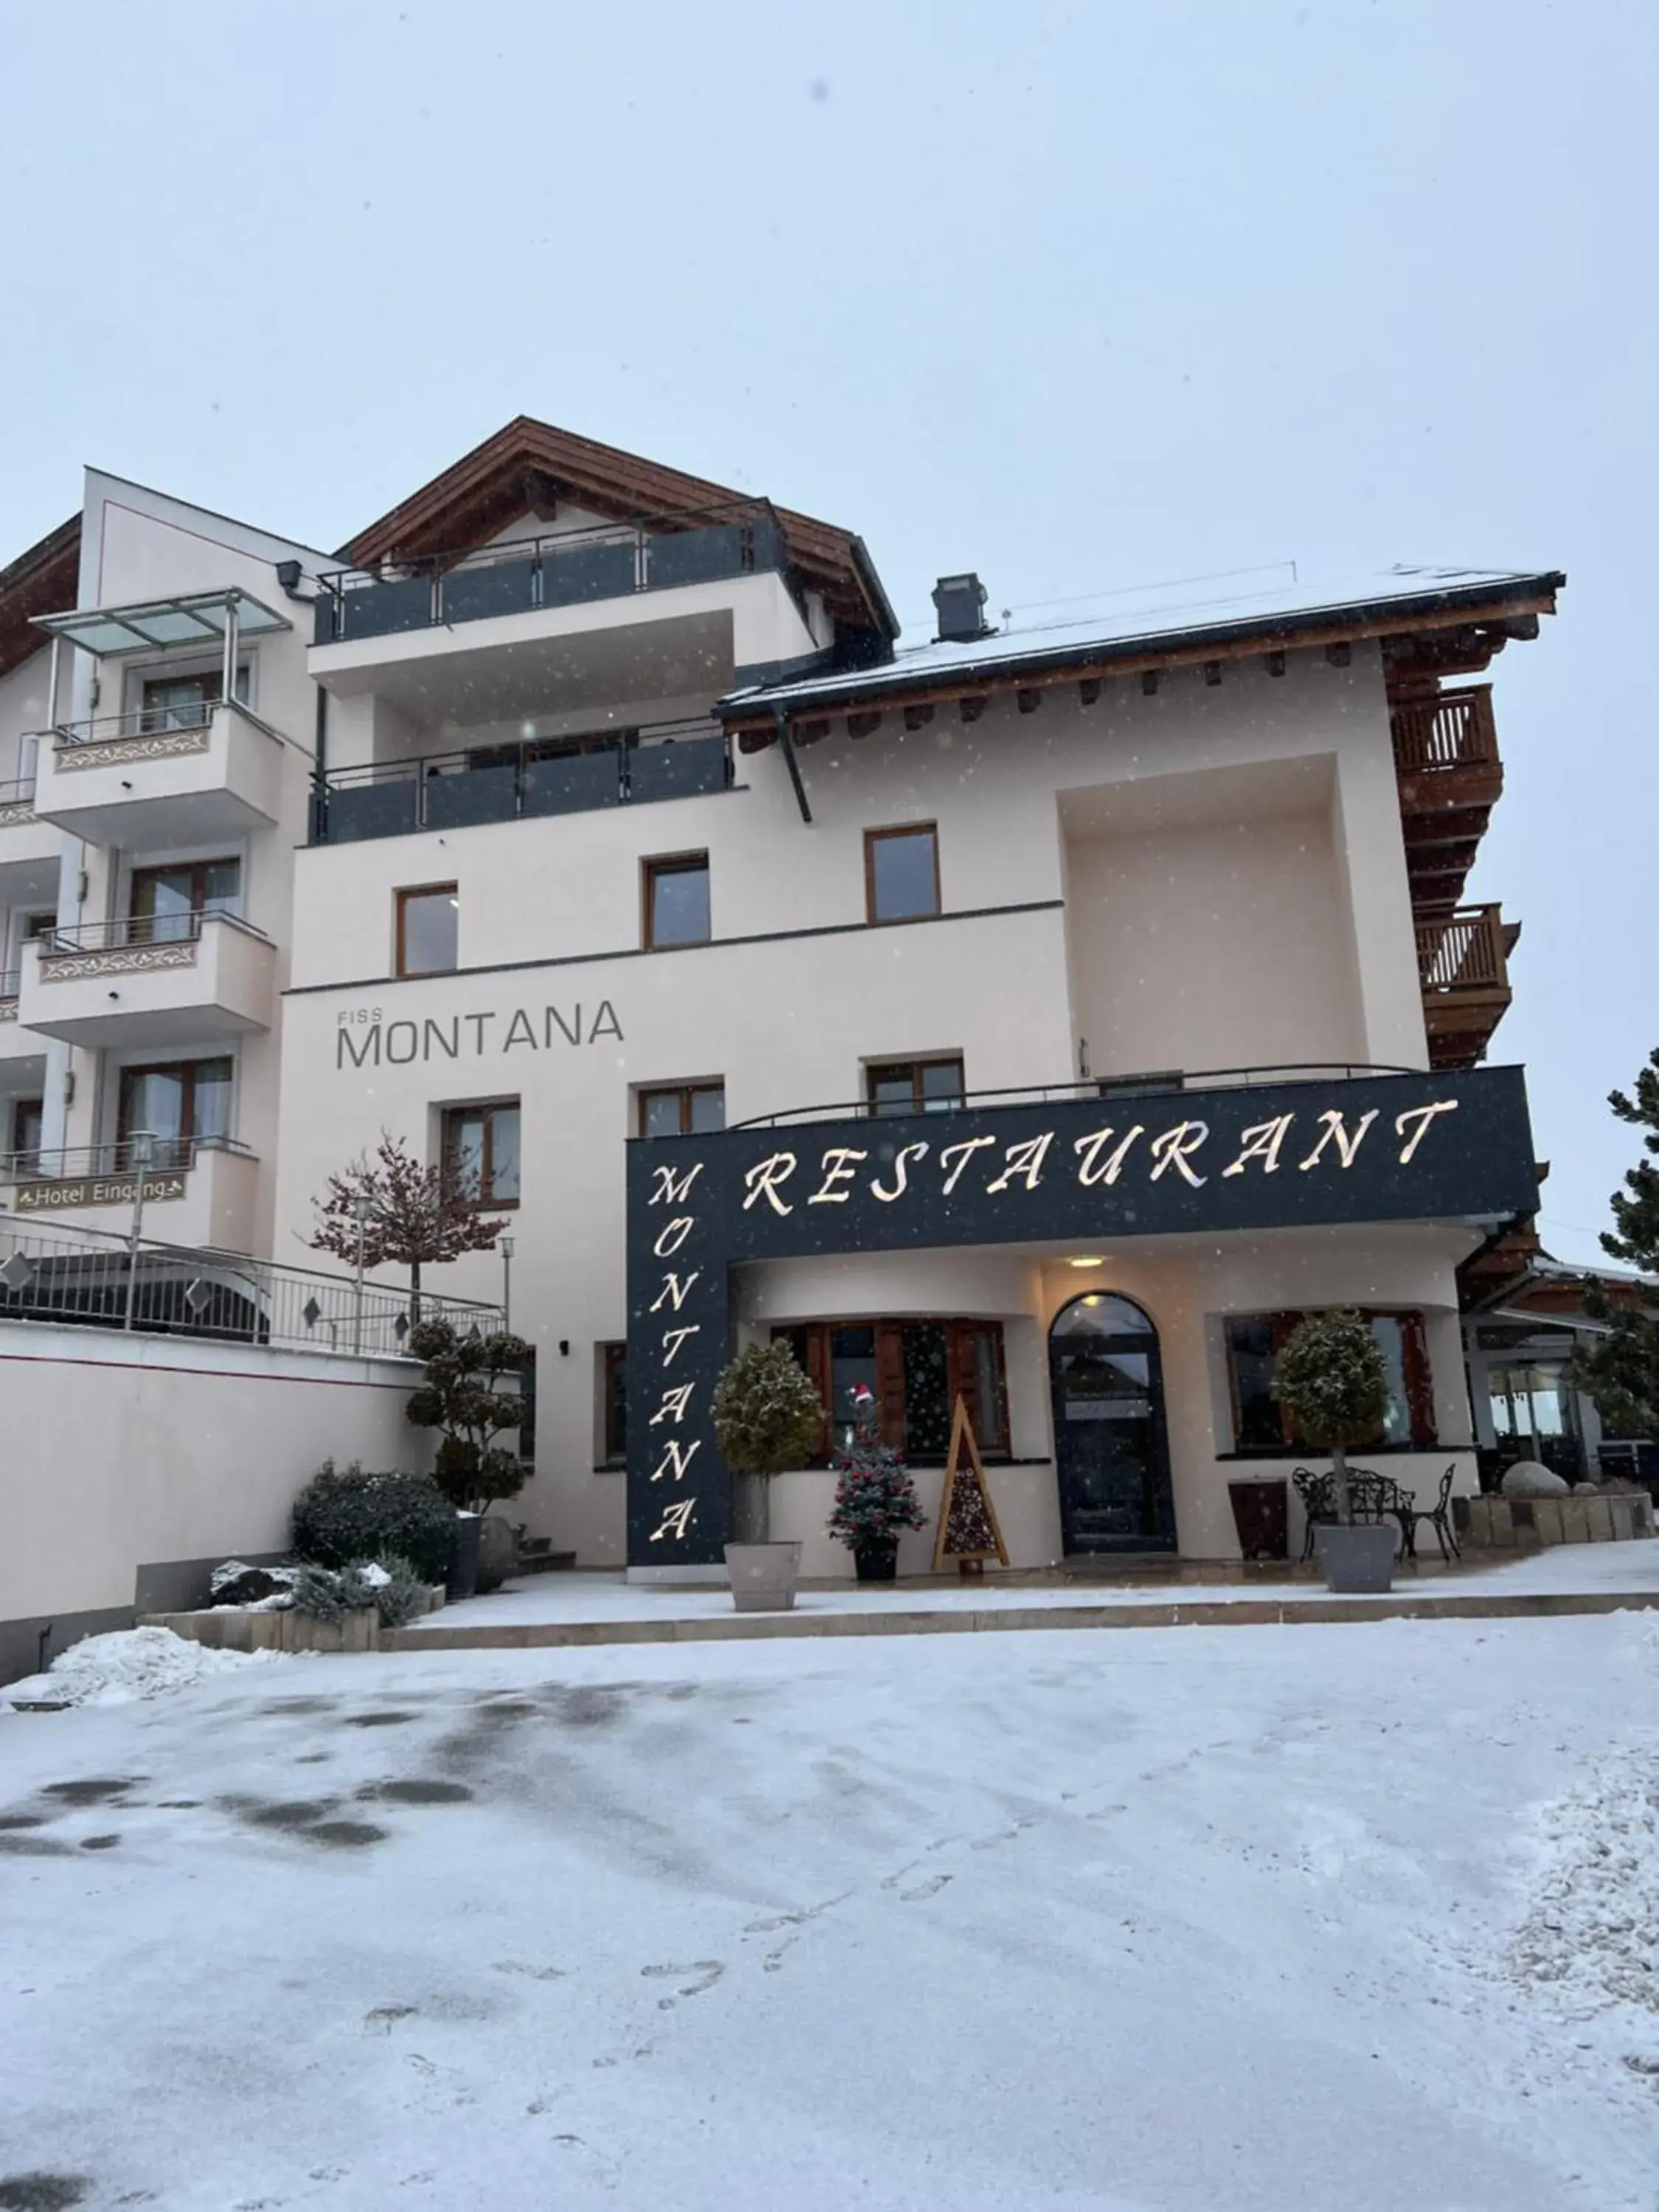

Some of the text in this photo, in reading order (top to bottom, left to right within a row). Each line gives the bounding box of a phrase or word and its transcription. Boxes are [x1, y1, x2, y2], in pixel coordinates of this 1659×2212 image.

[337, 1007, 382, 1025] FISS
[337, 1000, 624, 1069] MONTANA
[742, 1099, 1458, 1216] RESTAURANT
[35, 1184, 84, 1205] Hotel
[648, 1163, 704, 1541] MONTANA
